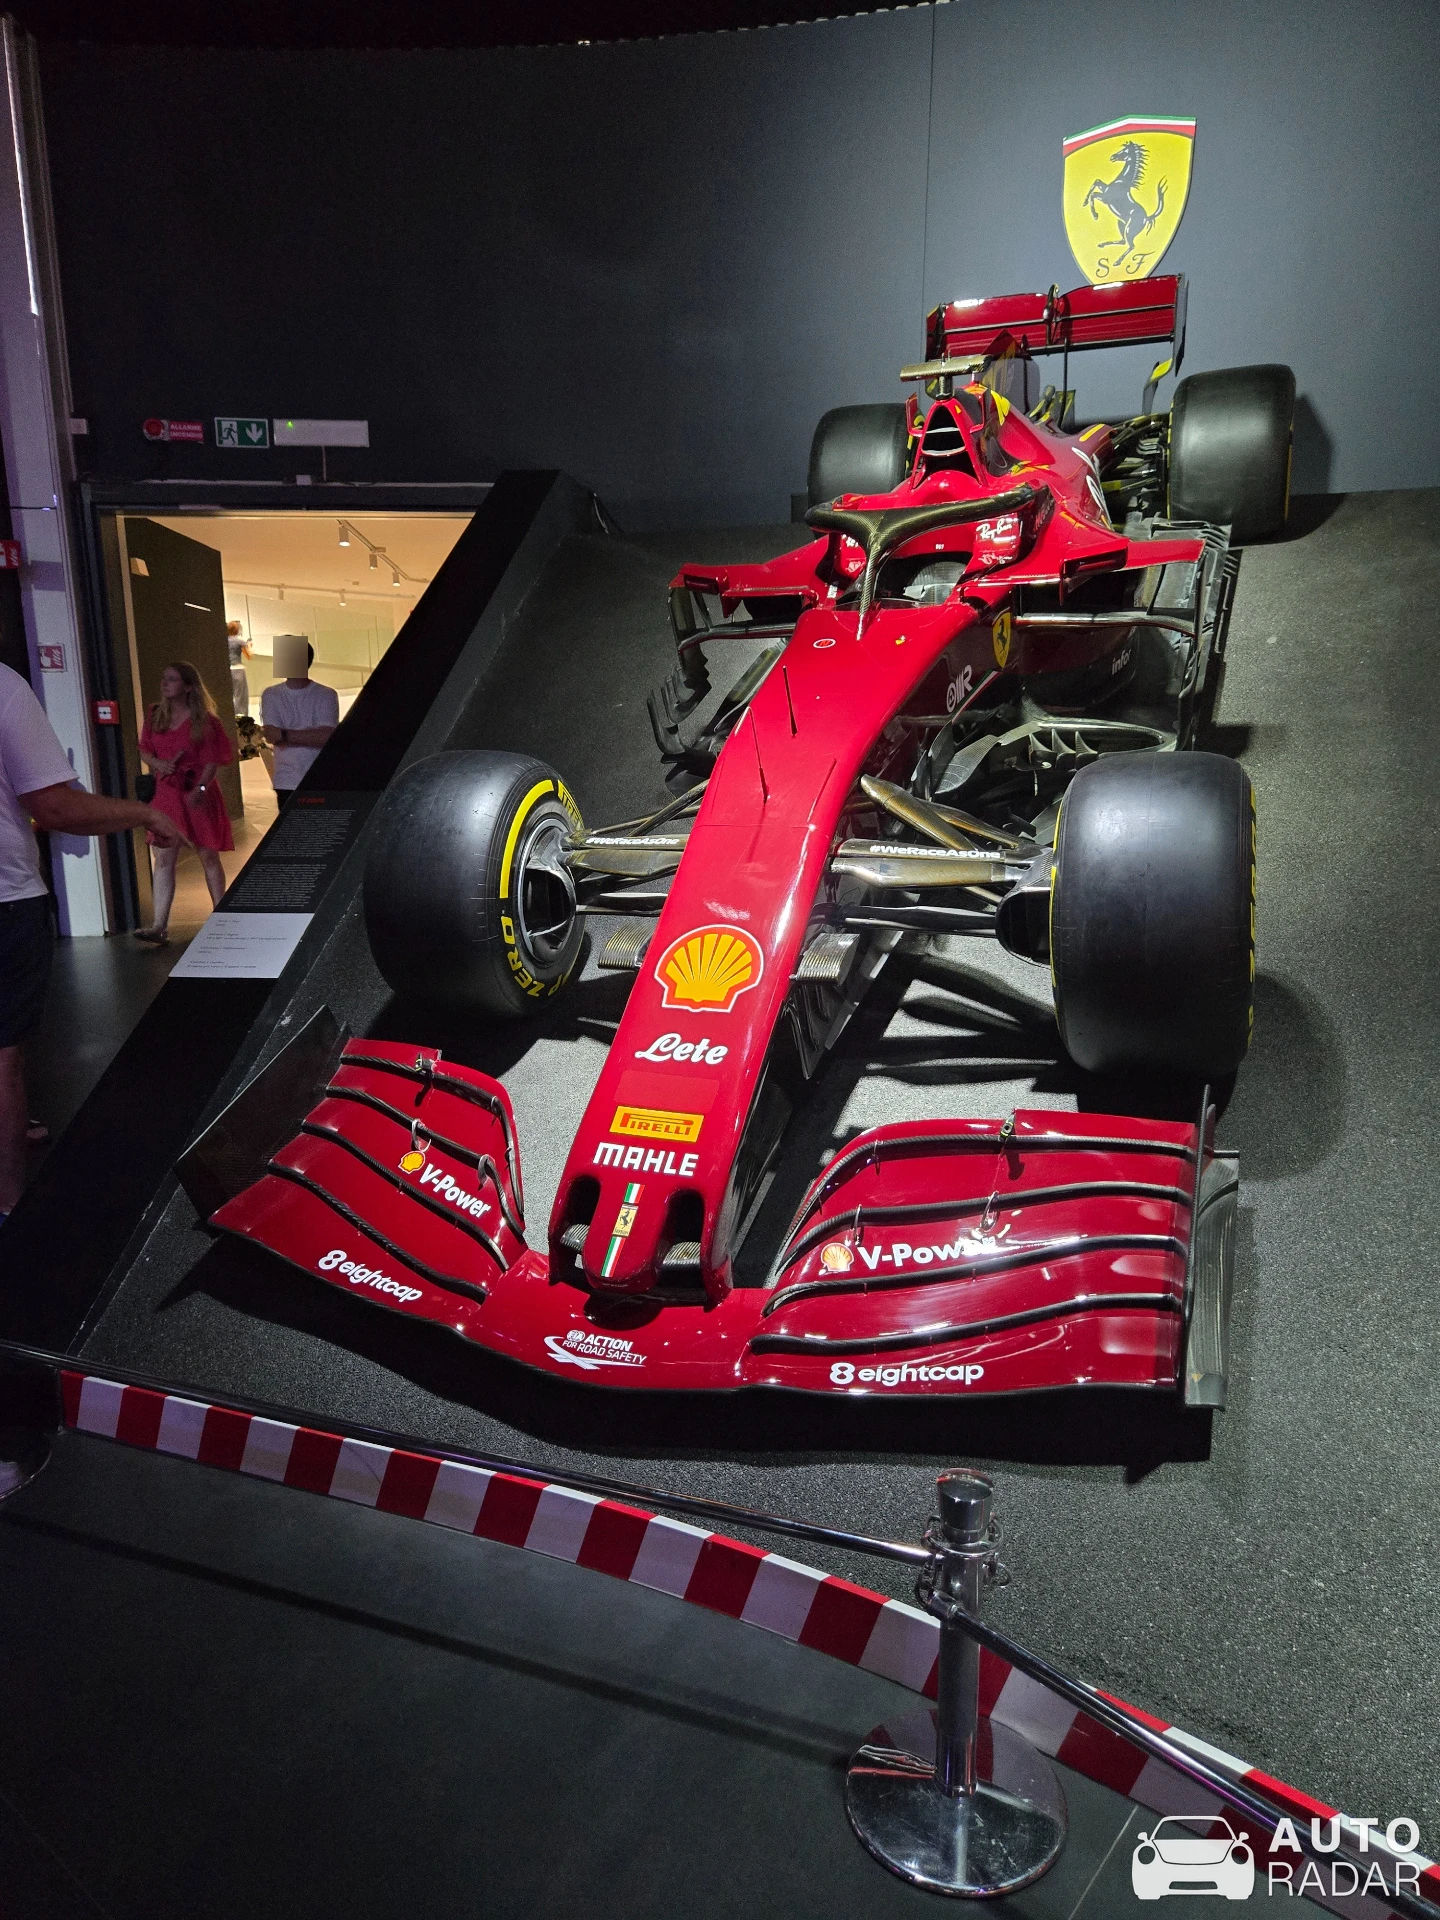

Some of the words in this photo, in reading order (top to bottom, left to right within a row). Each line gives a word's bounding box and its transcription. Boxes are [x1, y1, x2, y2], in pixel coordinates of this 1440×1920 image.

[1096, 257, 1110, 278] S
[1125, 251, 1156, 275] F
[1111, 649, 1132, 675] infor
[557, 779, 586, 834] PIRE
[869, 844, 1001, 859] #WeRaceAsOne
[500, 915, 546, 998] ZERO
[634, 1032, 729, 1065] Lete
[619, 1112, 695, 1136] PIRELLI
[592, 1141, 700, 1178] MAHLE
[419, 1163, 492, 1219] V-Power
[857, 1236, 996, 1270] V-Pow
[338, 1261, 423, 1303] eightcap
[562, 1340, 578, 1350] FOR
[577, 1343, 607, 1357] ROAD
[605, 1348, 648, 1365] SAFETY
[584, 1334, 634, 1352] ACTION
[857, 1363, 985, 1387] eightcap
